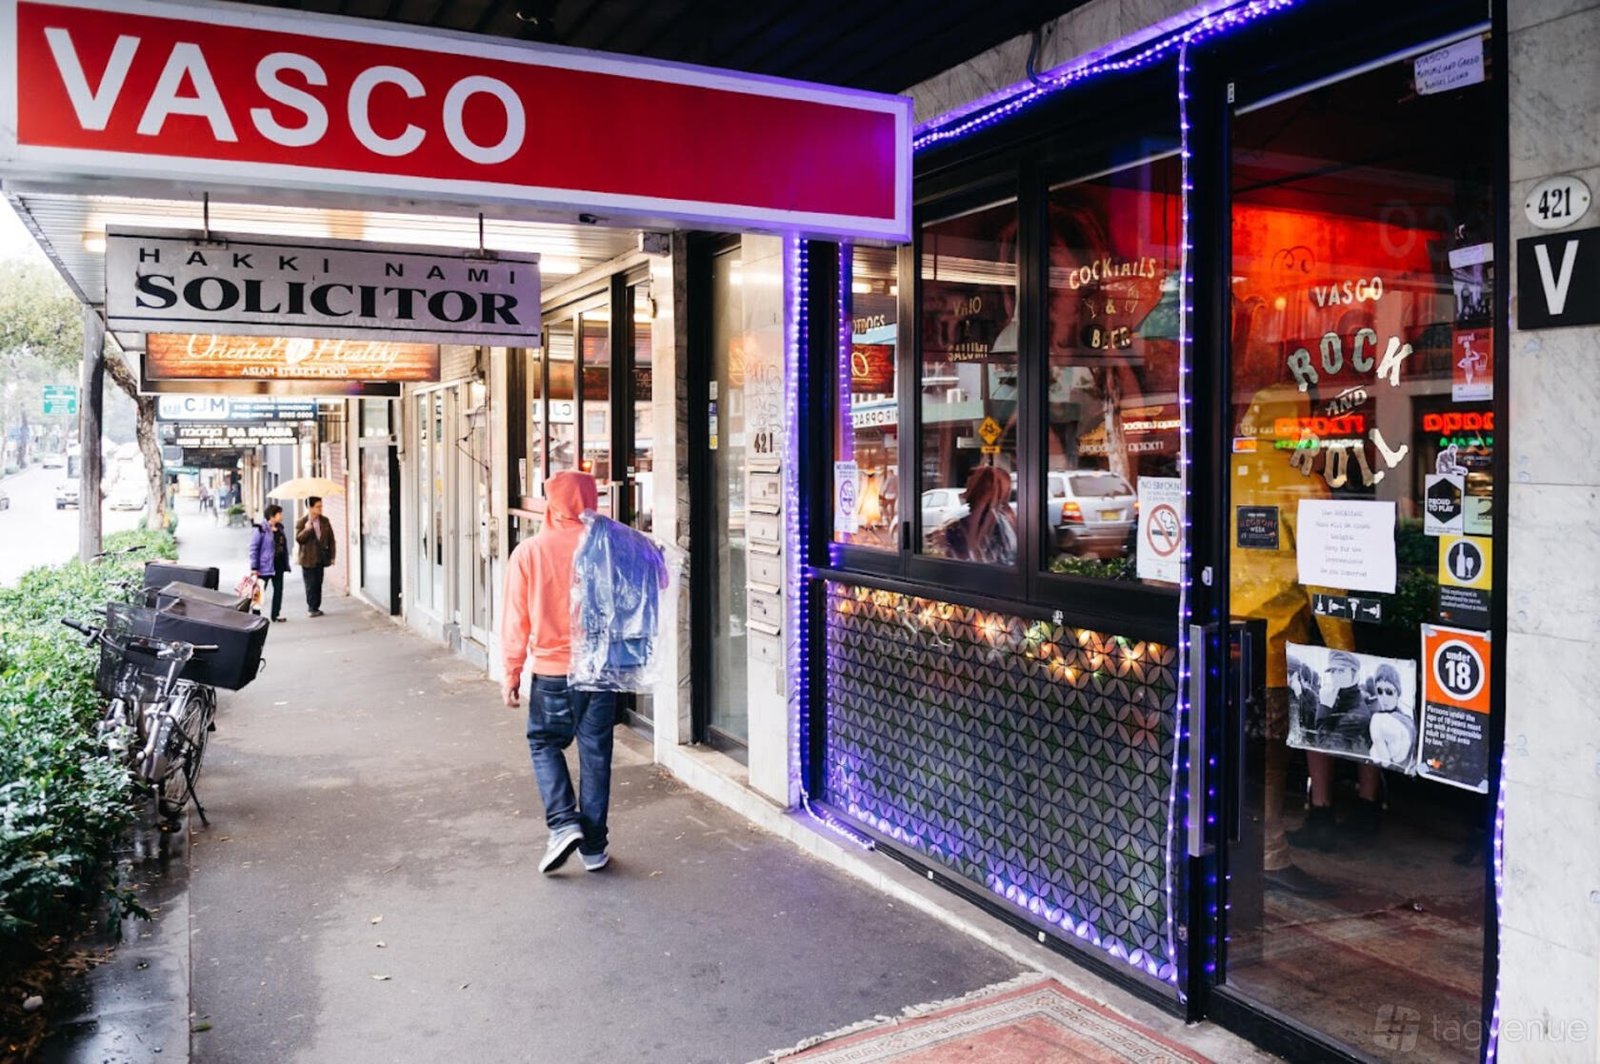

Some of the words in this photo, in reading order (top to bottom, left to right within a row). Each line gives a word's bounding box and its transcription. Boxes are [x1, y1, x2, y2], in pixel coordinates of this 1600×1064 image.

[44, 27, 526, 165] VASCO
[1538, 186, 1571, 220] 421
[139, 247, 329, 274] HAKKI
[385, 262, 516, 285] NAMI
[1534, 239, 1579, 315] V
[135, 274, 522, 325] SOLICITOR
[1315, 276, 1384, 307] VASCO
[241, 366, 275, 376] ASIAN
[277, 366, 317, 377] STREET
[319, 367, 349, 377] FOOD
[1287, 328, 1413, 393] ROCK
[1325, 389, 1368, 416] AND
[754, 432, 773, 453] 421
[1290, 428, 1409, 488] ROLL
[1153, 481, 1180, 490] SMOKIN
[1446, 651, 1472, 662] under
[1445, 661, 1471, 690] 18
[1427, 704, 1449, 716] Persons
[1465, 713, 1476, 722] the
